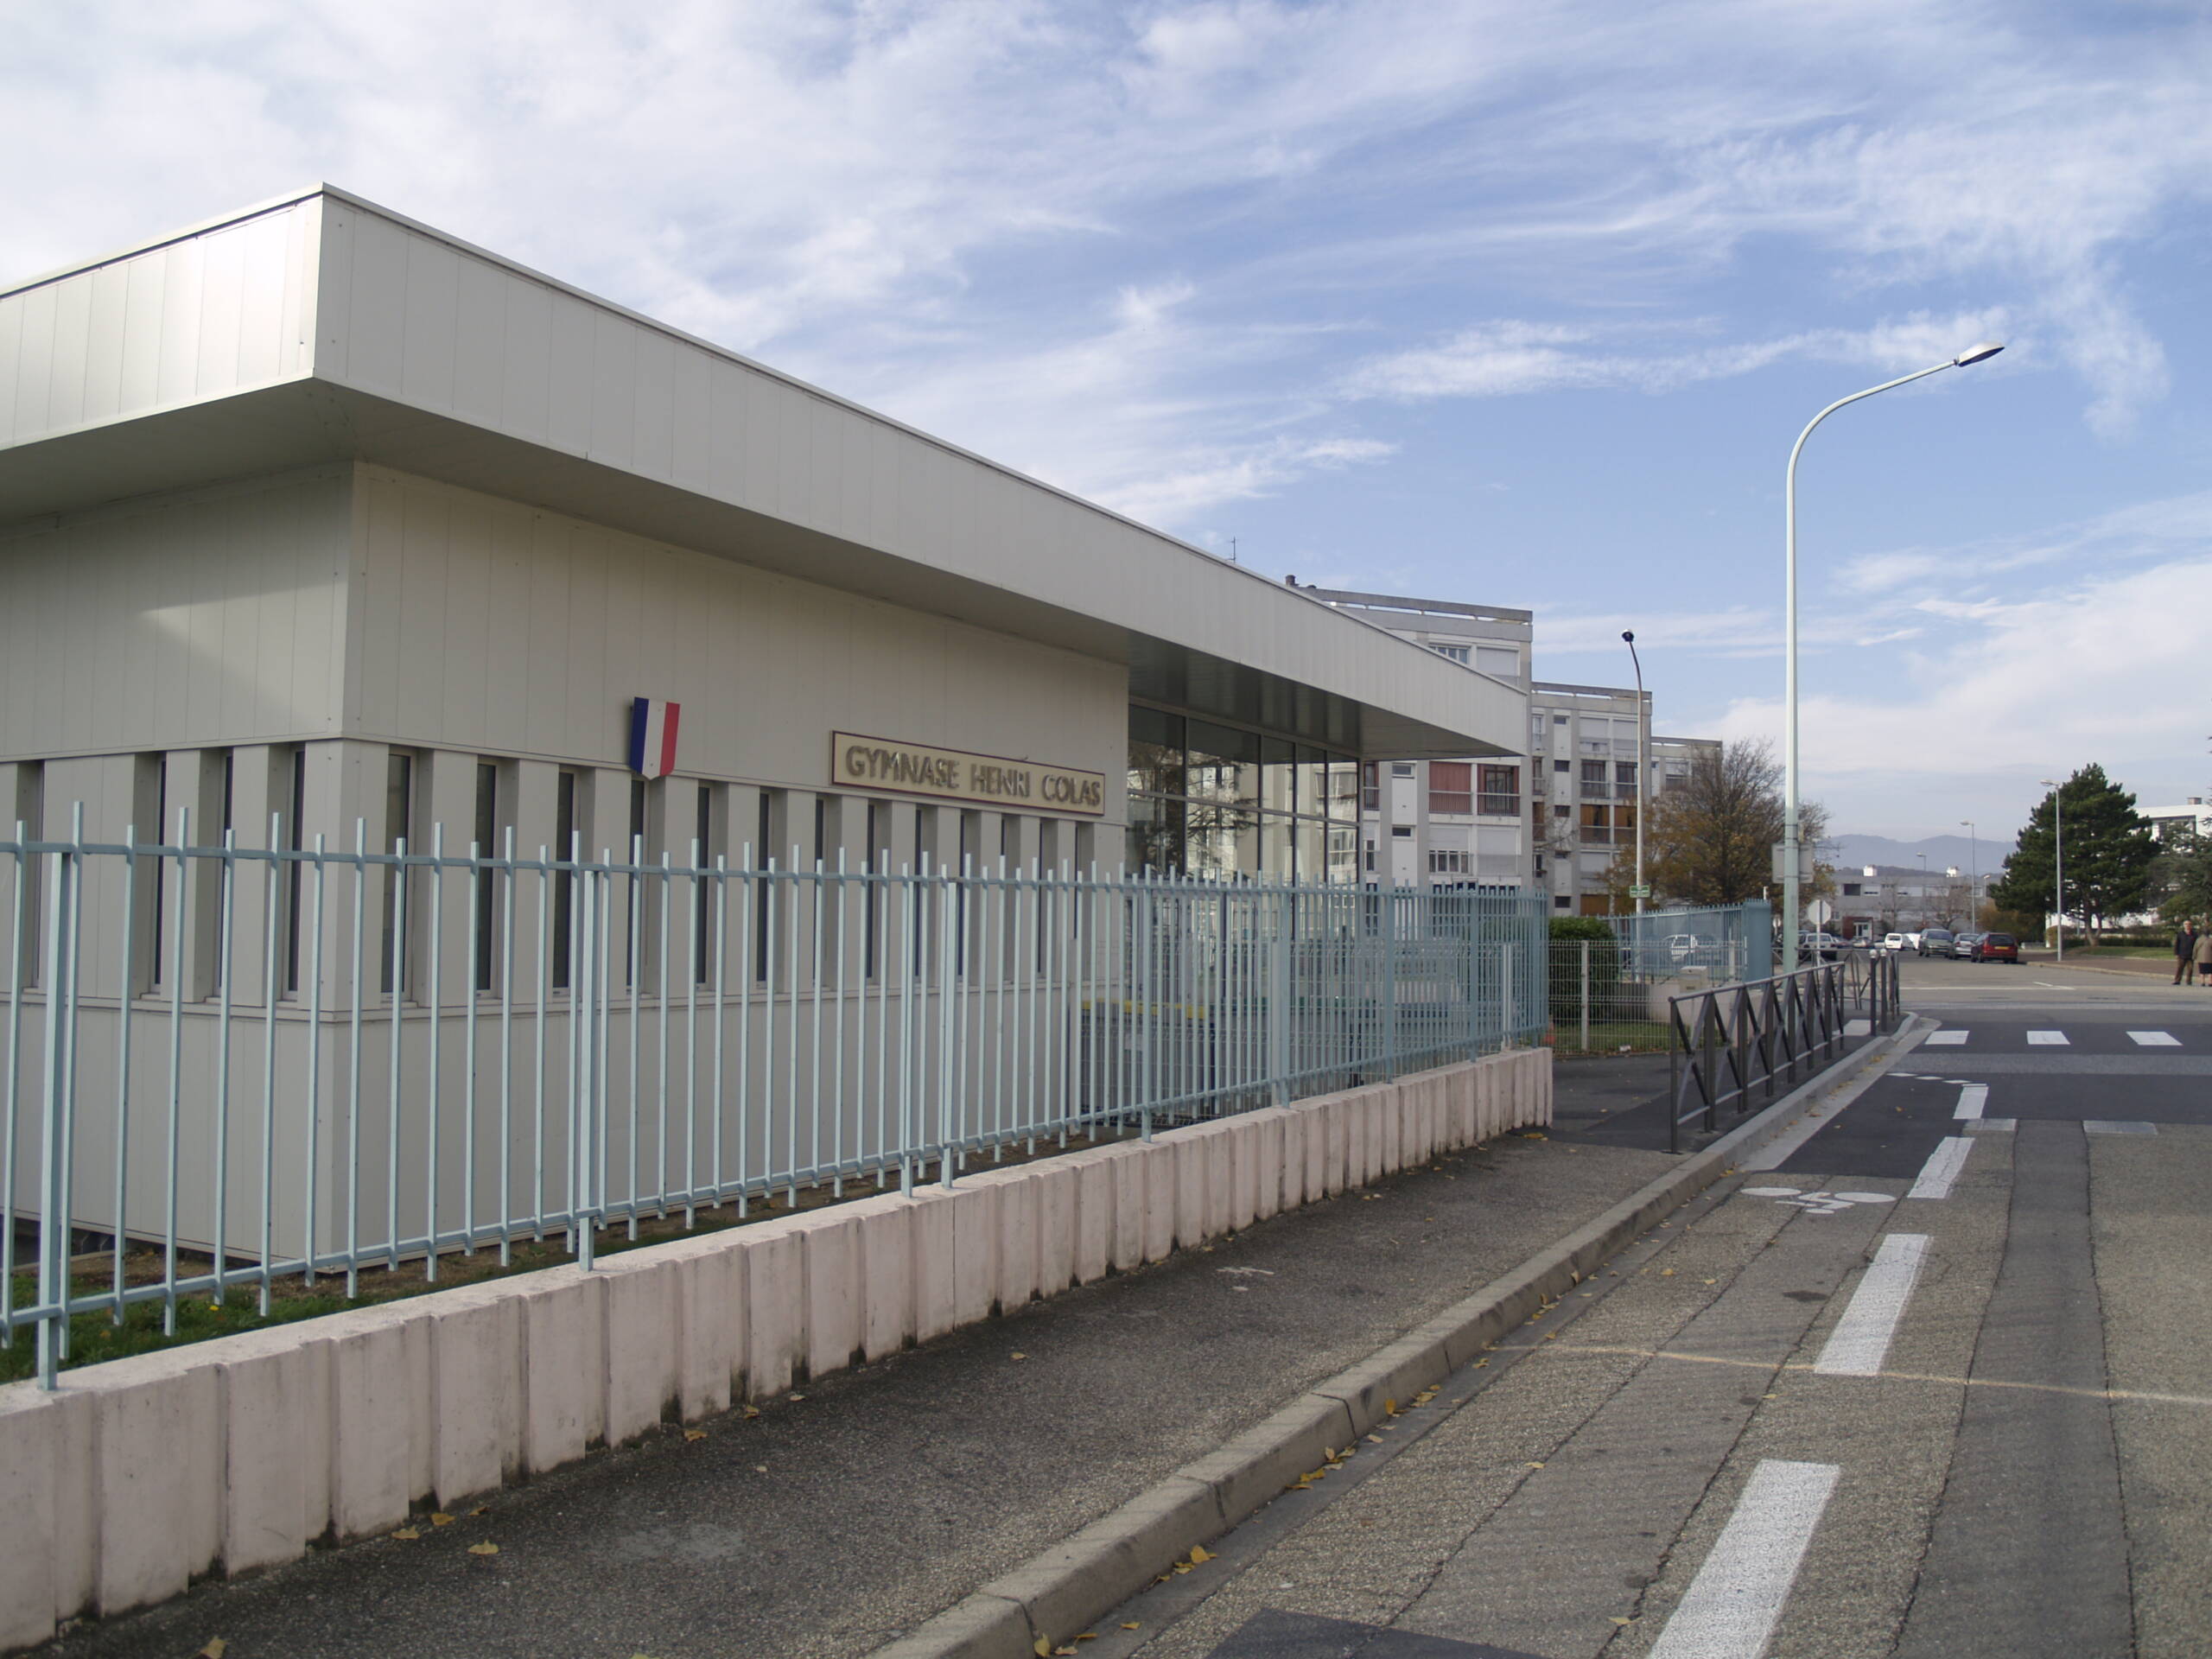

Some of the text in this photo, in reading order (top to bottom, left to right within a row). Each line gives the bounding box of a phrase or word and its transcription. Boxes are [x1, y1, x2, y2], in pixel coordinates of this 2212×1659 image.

[846, 745, 1102, 806] GYMNASE HENRI COLAS
